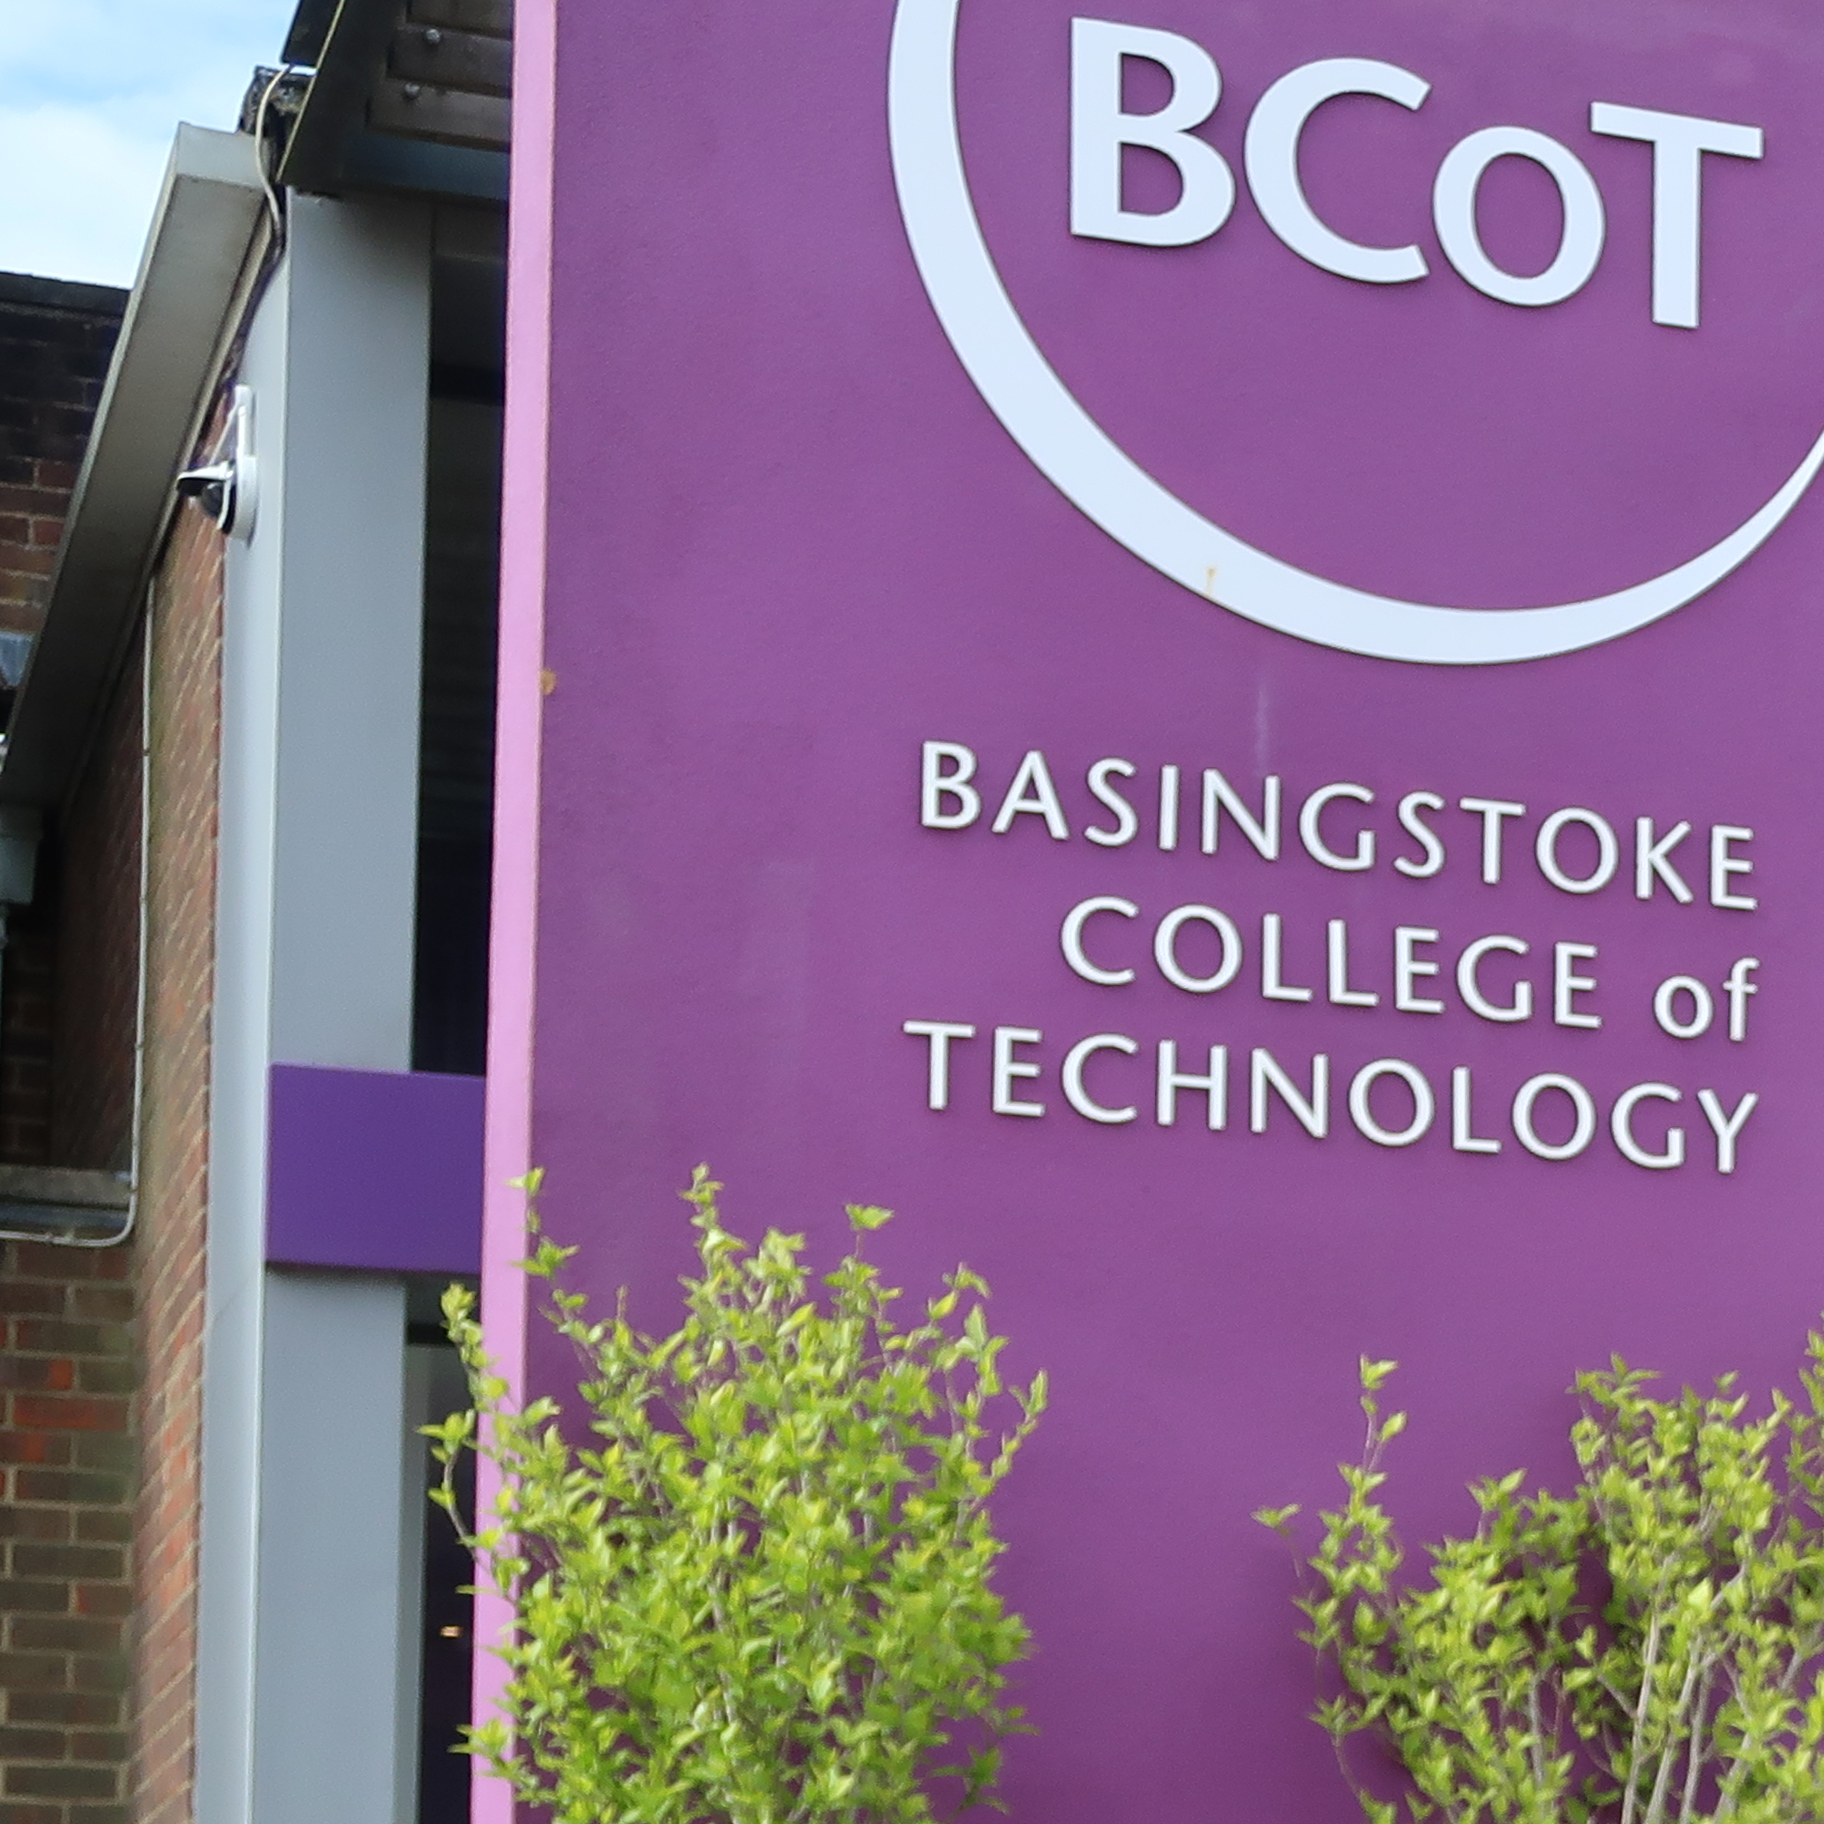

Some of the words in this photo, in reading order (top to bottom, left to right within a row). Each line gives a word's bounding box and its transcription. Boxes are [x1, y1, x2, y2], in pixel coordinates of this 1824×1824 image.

[920, 739, 1758, 911] BASINGSTOKE
[1059, 893, 1604, 1031] COLLEGE
[1652, 956, 1759, 1043] of
[901, 1018, 1758, 1175] TECHNOLOGY
